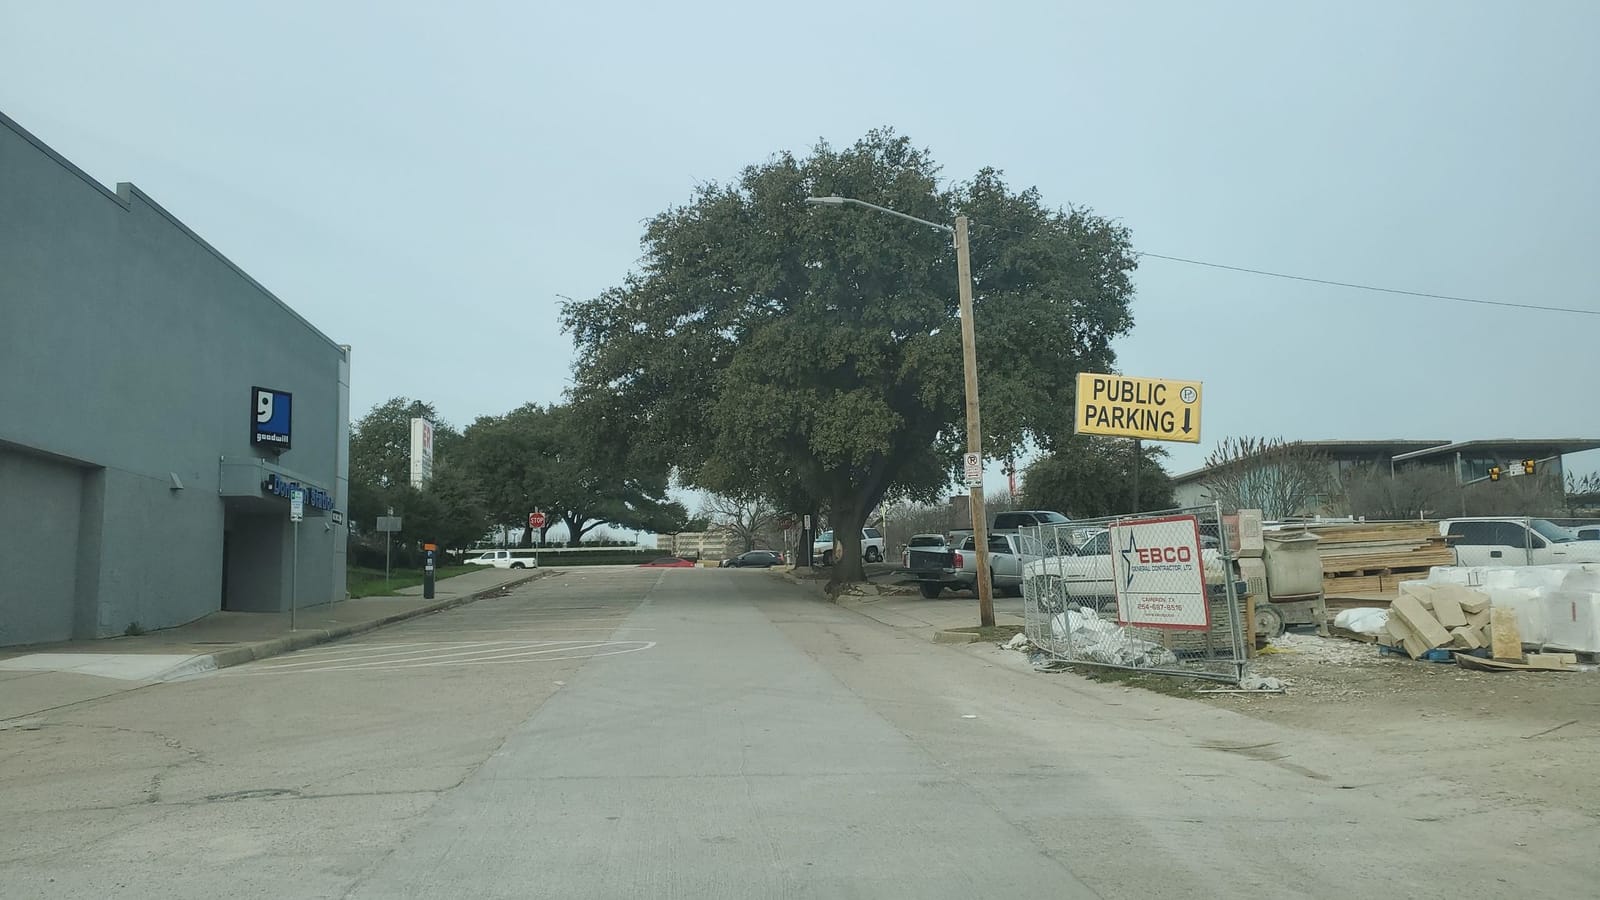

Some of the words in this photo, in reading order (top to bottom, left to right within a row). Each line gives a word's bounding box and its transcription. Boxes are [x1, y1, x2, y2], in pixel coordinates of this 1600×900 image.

[1093, 379, 1166, 405] PUBLIC
[1085, 404, 1175, 433] PARKING
[256, 433, 289, 443] goodwill
[1136, 546, 1191, 563] EBCO
